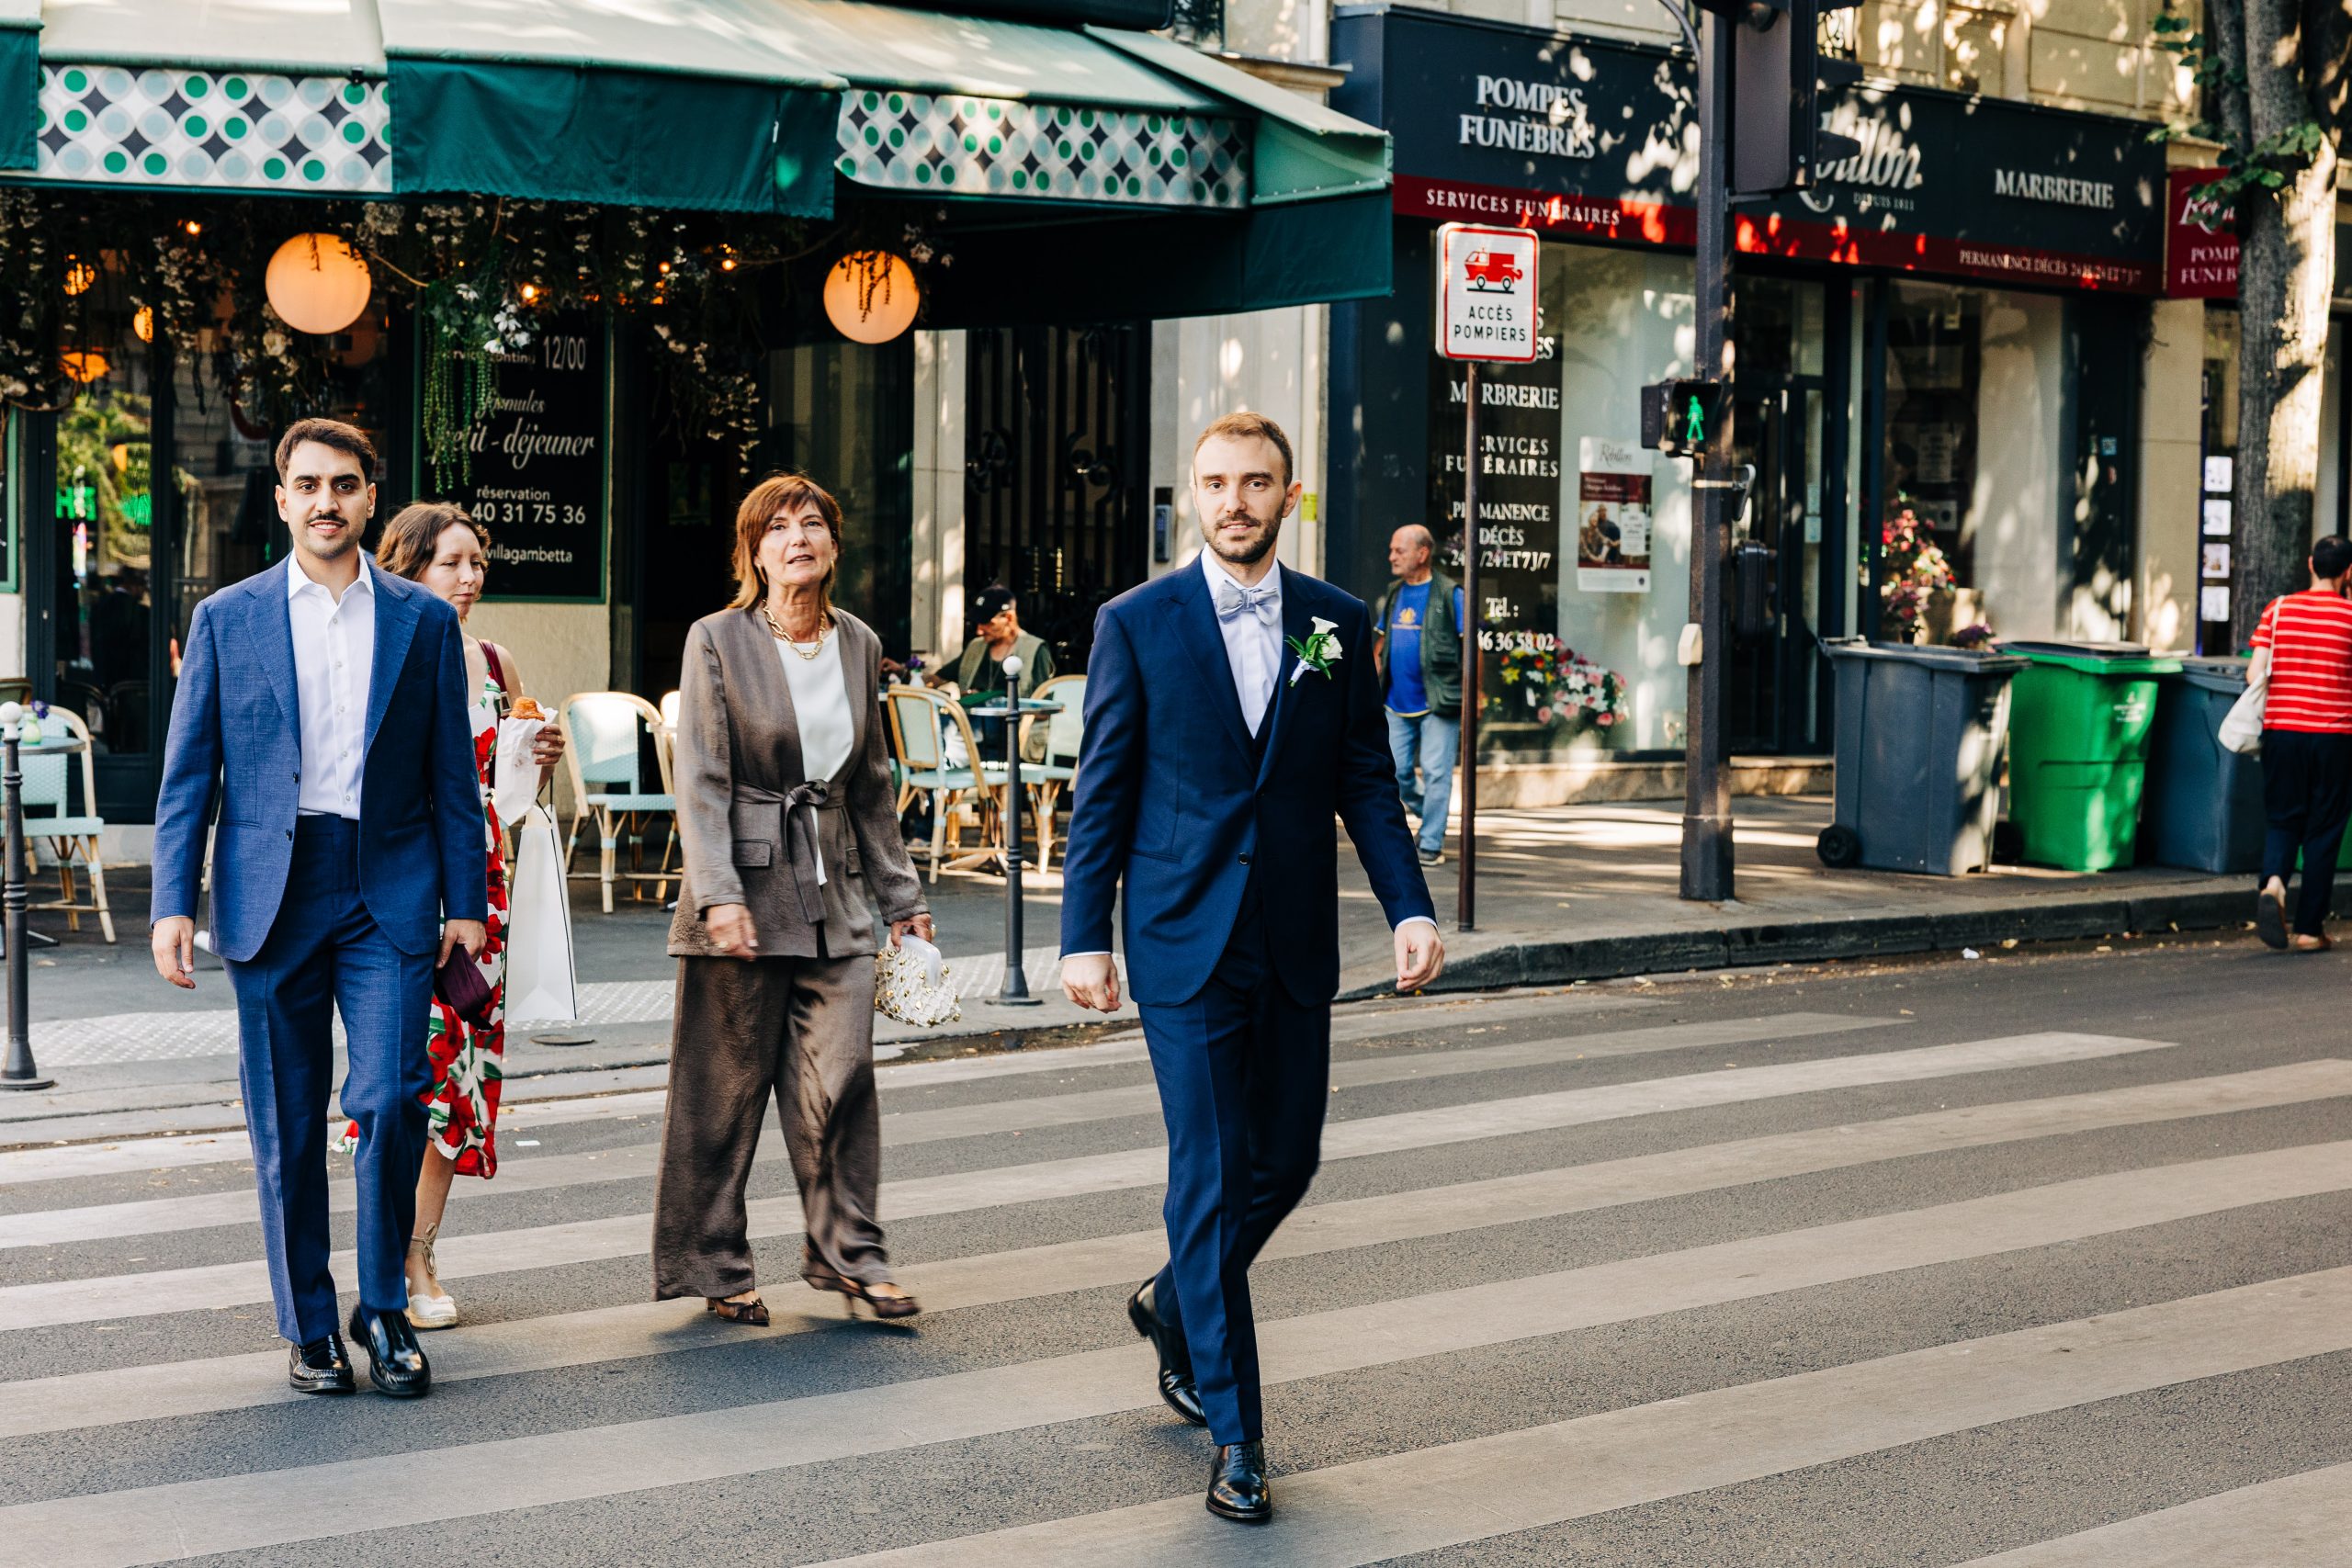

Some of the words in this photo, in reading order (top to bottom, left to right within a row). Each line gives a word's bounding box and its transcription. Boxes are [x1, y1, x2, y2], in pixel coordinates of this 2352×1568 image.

[1476, 74, 1588, 117] POMPES
[1459, 114, 1596, 159] FUNÈBRES
[1995, 168, 2115, 209] MARBRERIE
[1426, 189, 1509, 213] SERVICES
[2190, 244, 2240, 263] POMP
[1469, 304, 1512, 321] ACCÈS
[1454, 324, 1526, 342] POMPIERS
[1450, 380, 1559, 410] MRBRERIE
[1480, 434, 1549, 456] RVICES
[1445, 454, 1559, 478] FUÉRAIRES
[476, 485, 550, 501] réservation
[471, 502, 495, 524] 40
[502, 503, 524, 524] 31
[532, 504, 556, 525] 75
[562, 505, 586, 525] 36
[1453, 501, 1551, 522] PMANENCE
[1479, 525, 1525, 547] DÉCÈS
